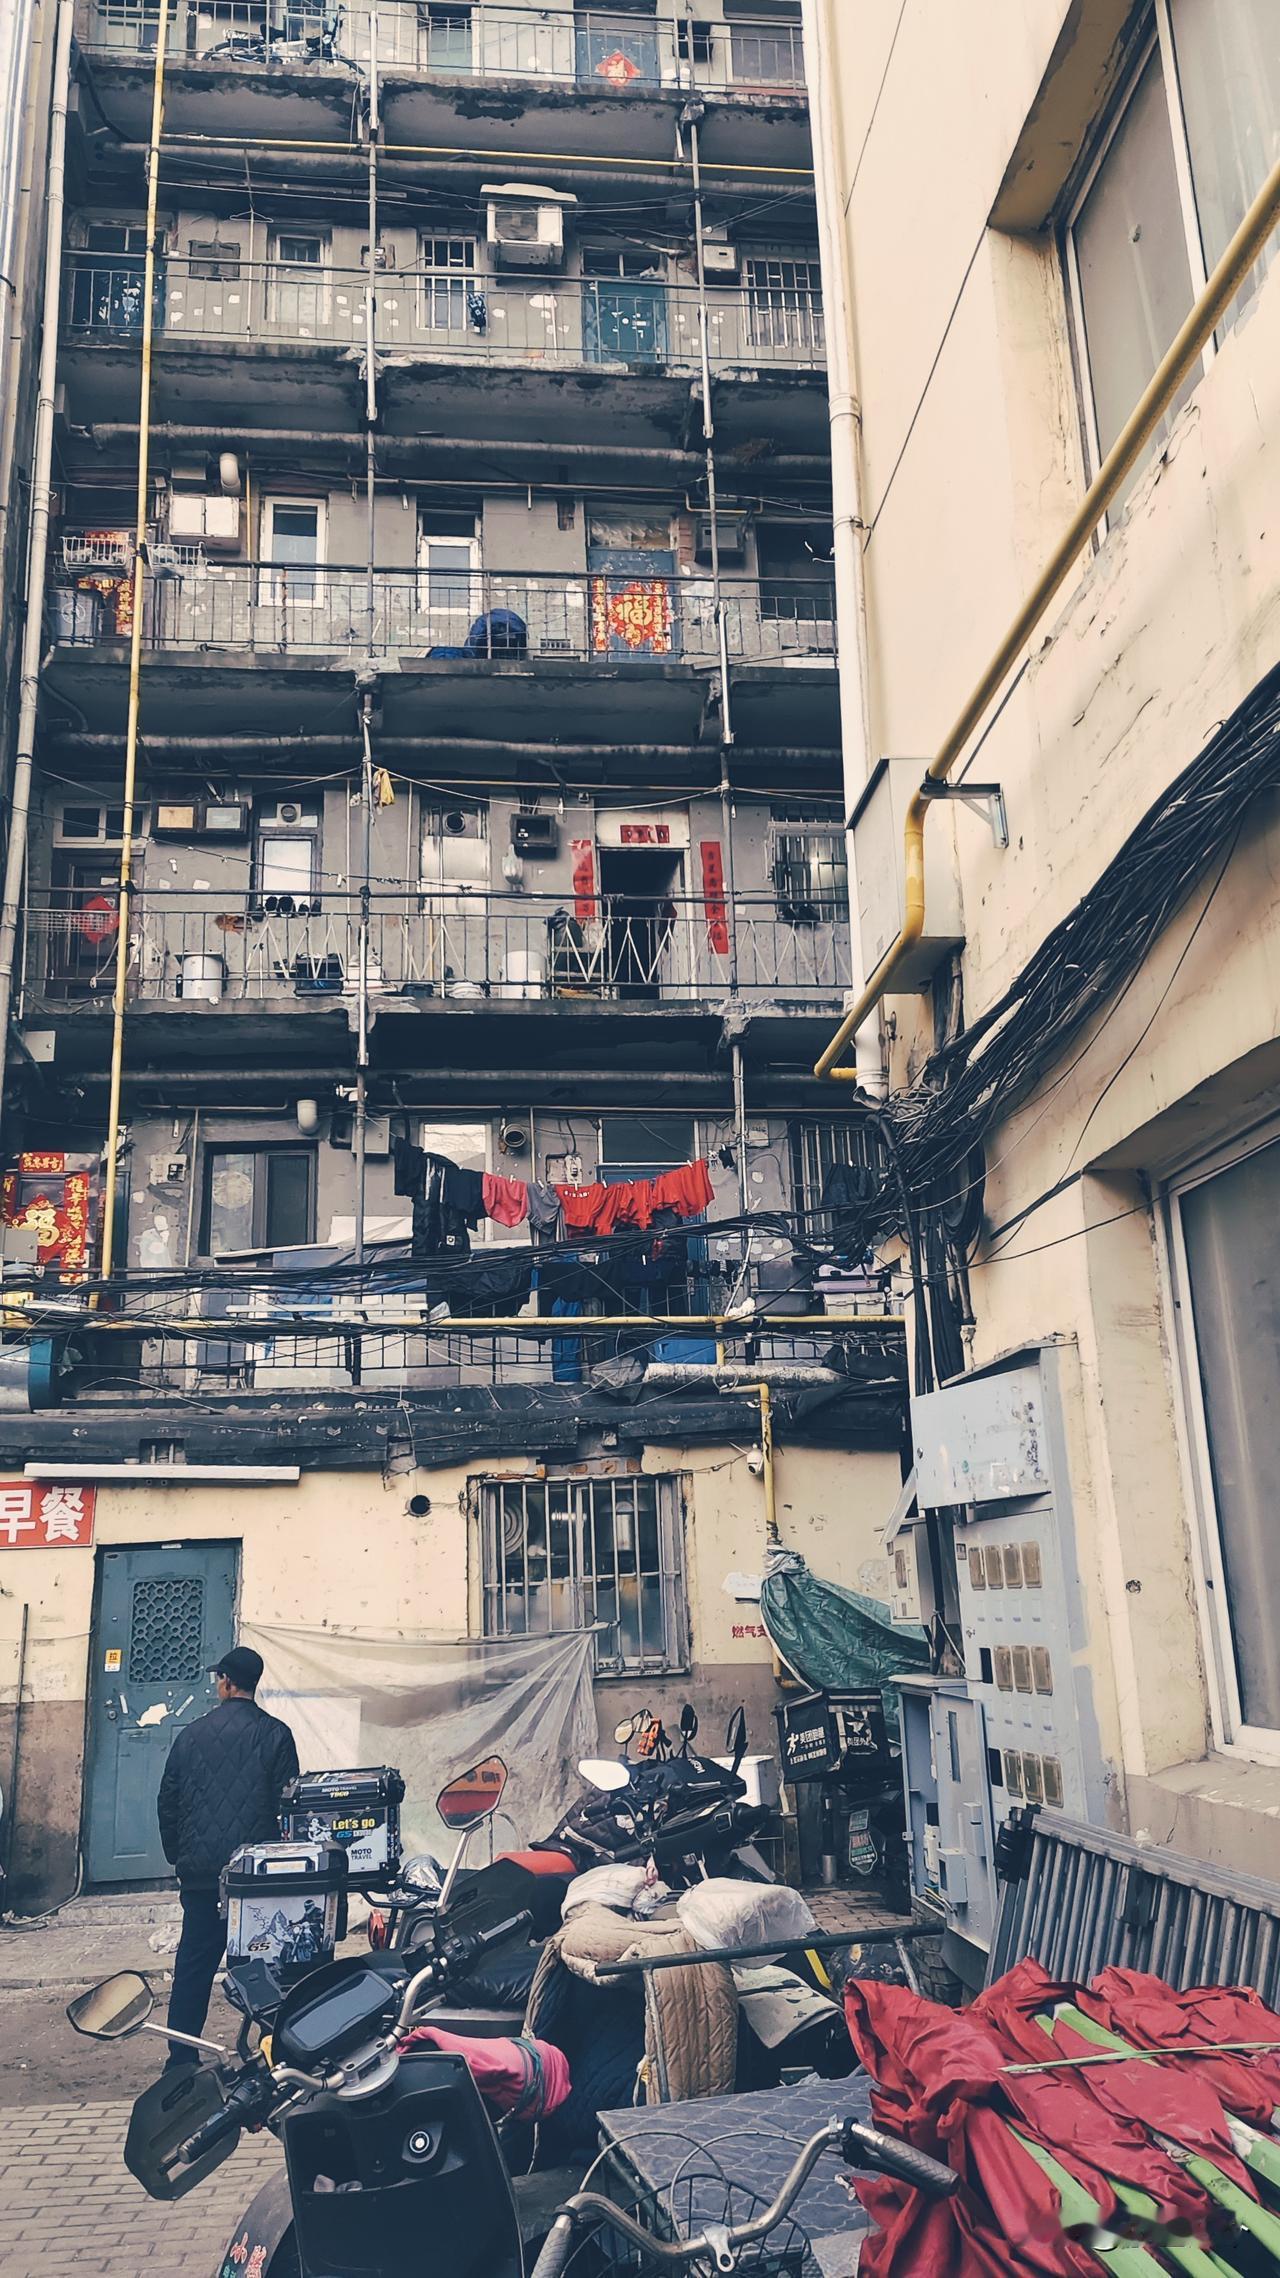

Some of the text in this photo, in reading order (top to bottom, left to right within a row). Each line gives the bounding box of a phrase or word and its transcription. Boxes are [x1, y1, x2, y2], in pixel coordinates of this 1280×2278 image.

[0, 1486, 84, 1543] 早餐
[332, 1818, 376, 1831] Let's go
[247, 1942, 271, 1952] GS
